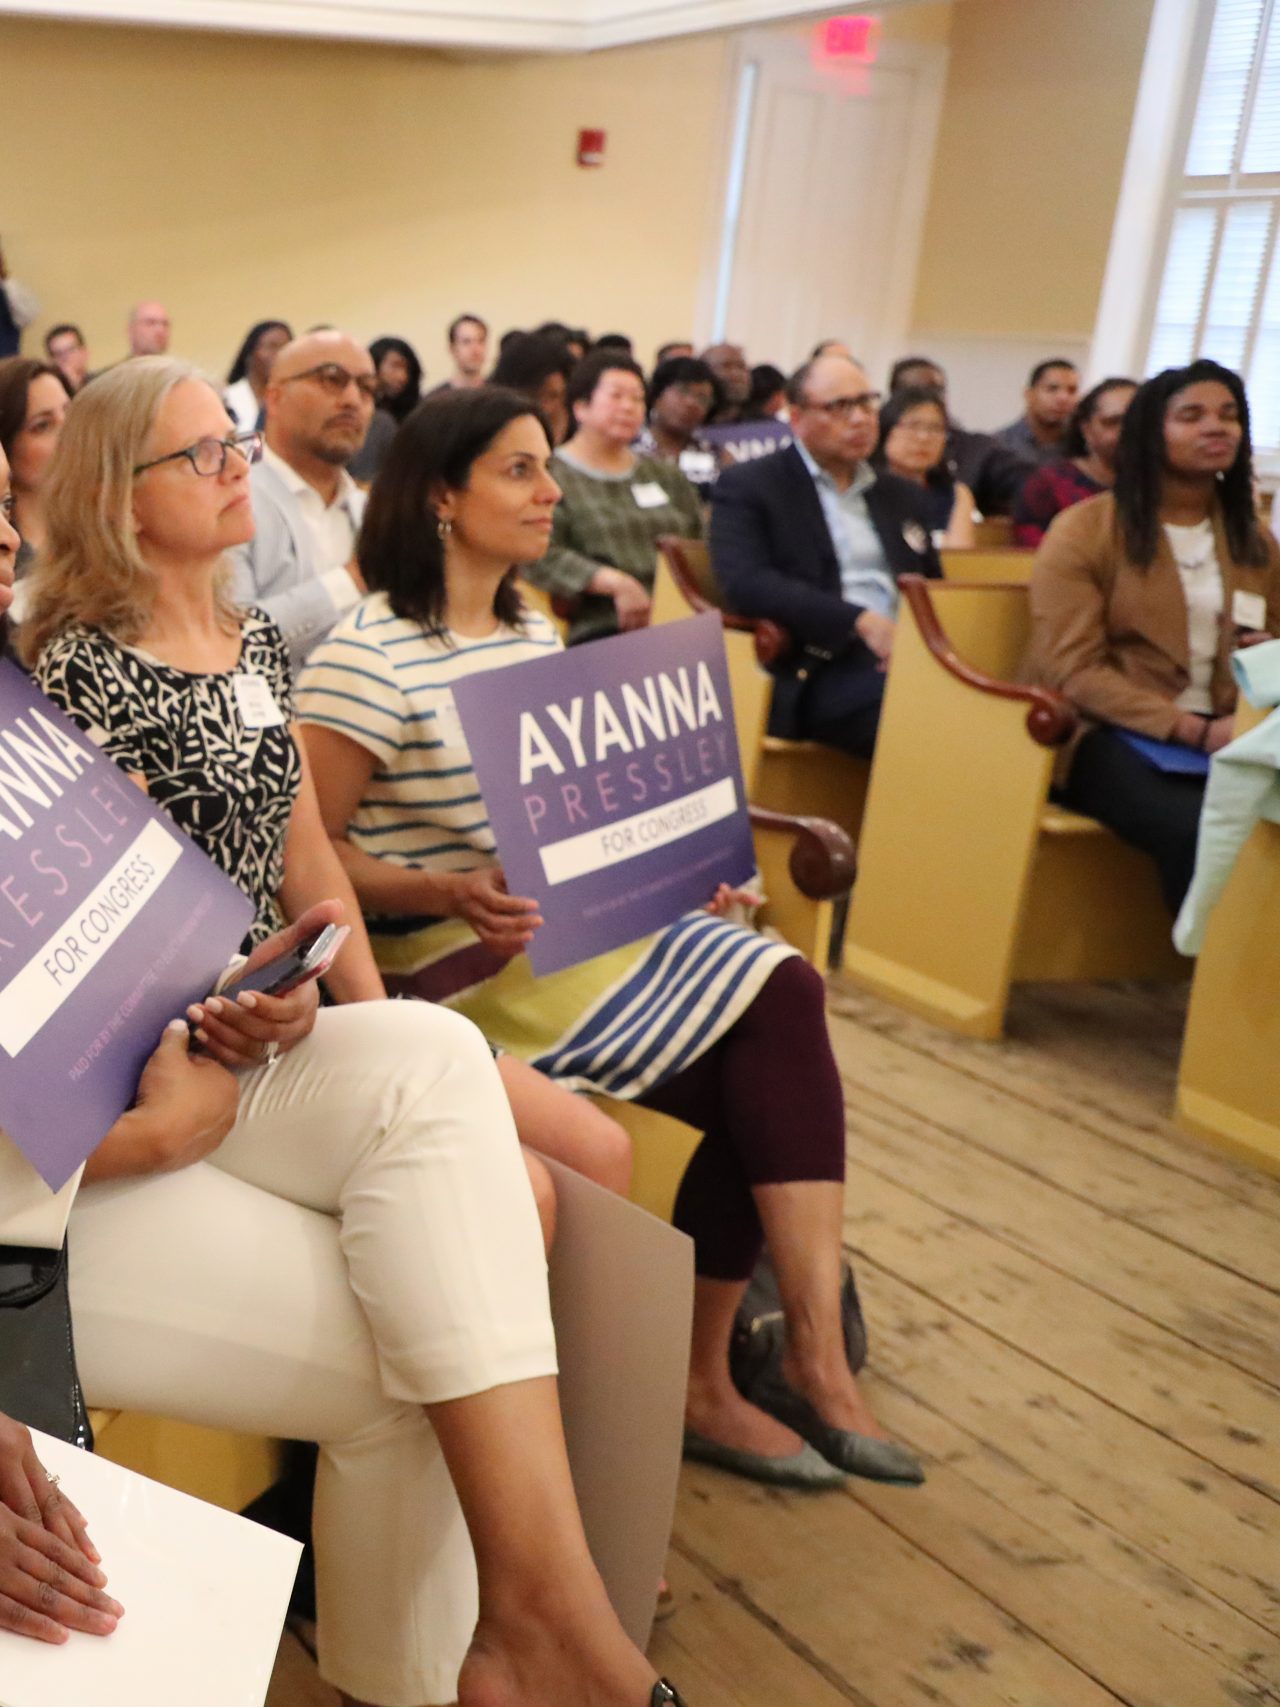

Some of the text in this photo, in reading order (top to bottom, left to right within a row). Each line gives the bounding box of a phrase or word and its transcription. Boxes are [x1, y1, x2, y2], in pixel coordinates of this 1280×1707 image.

[518, 660, 723, 785] AYANNA
[523, 731, 729, 836] PRESSLEY
[601, 799, 708, 857] FOR CONGRESS
[43, 855, 157, 986] FOR CONGRESS
[67, 1056, 90, 1081] PAID
[83, 1037, 105, 1061] FOR
